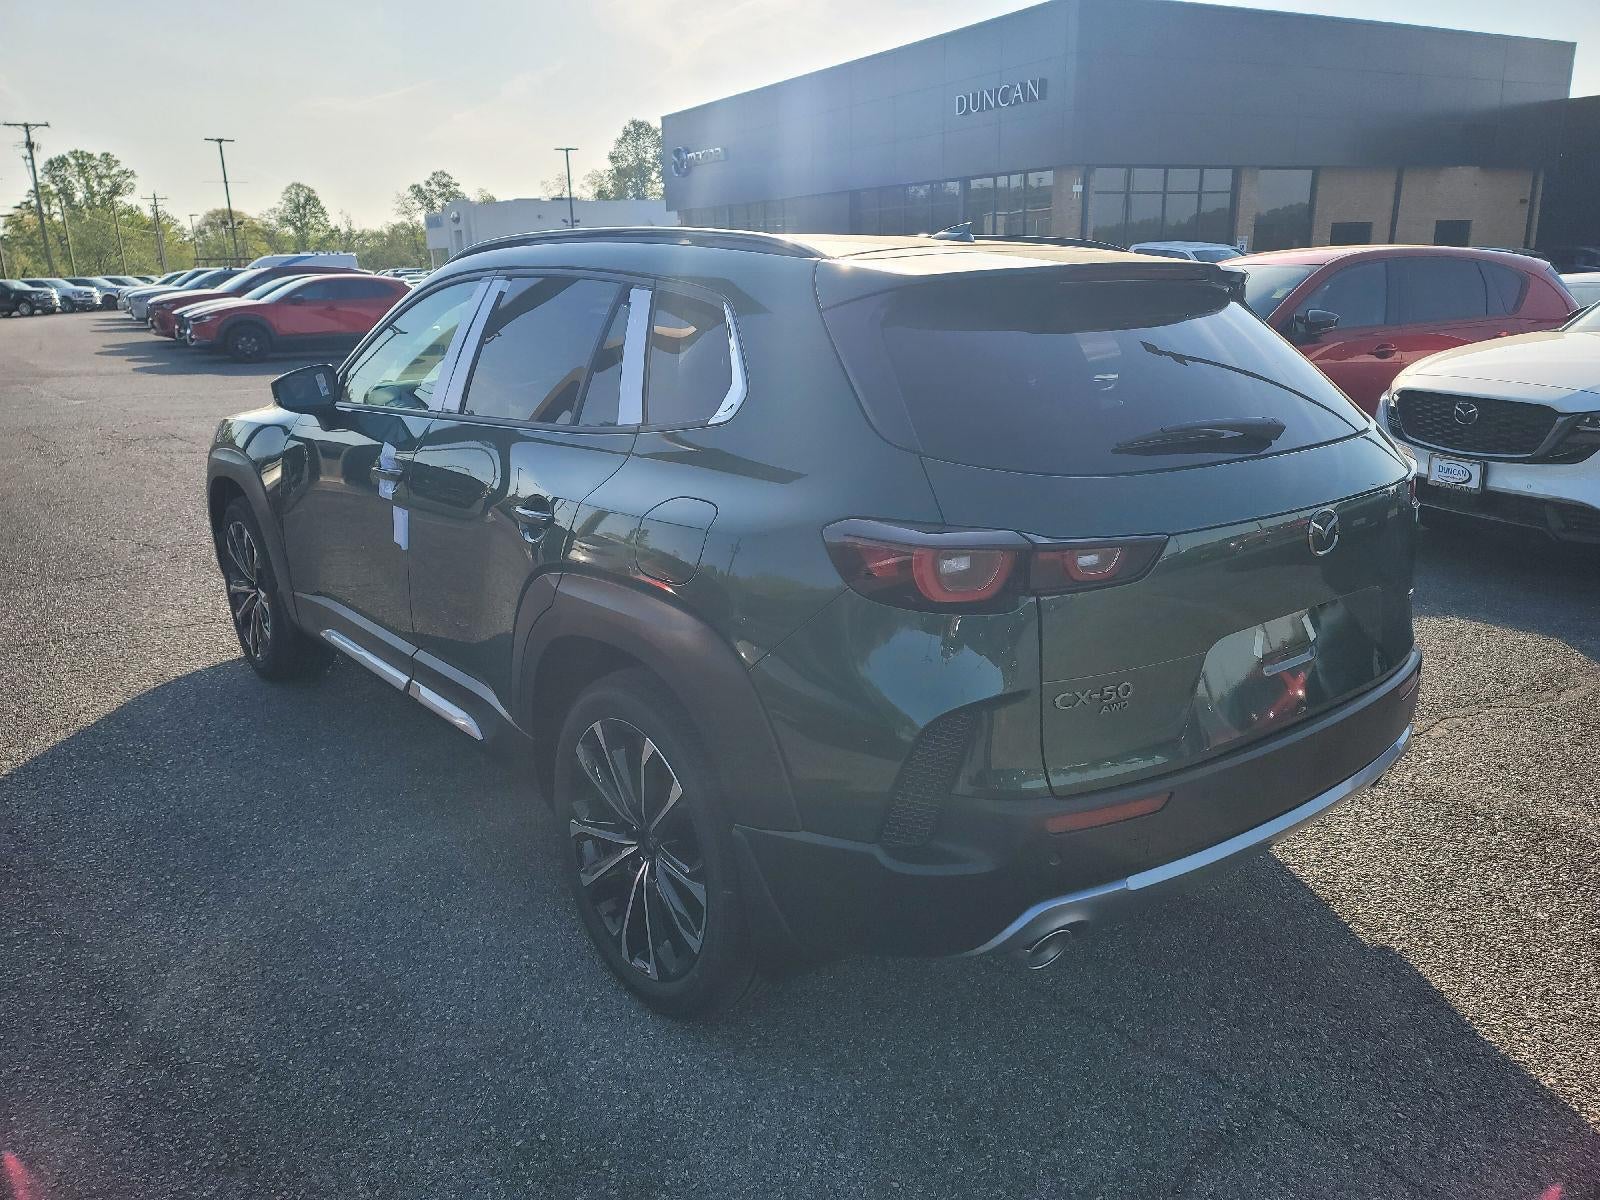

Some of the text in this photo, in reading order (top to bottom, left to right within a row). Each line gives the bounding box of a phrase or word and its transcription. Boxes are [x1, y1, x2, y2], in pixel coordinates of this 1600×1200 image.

[955, 78, 1040, 115] DUNCAN
[1438, 464, 1467, 477] DUNCAN
[1054, 681, 1133, 710] CX-50
[1100, 700, 1129, 715] AWD
